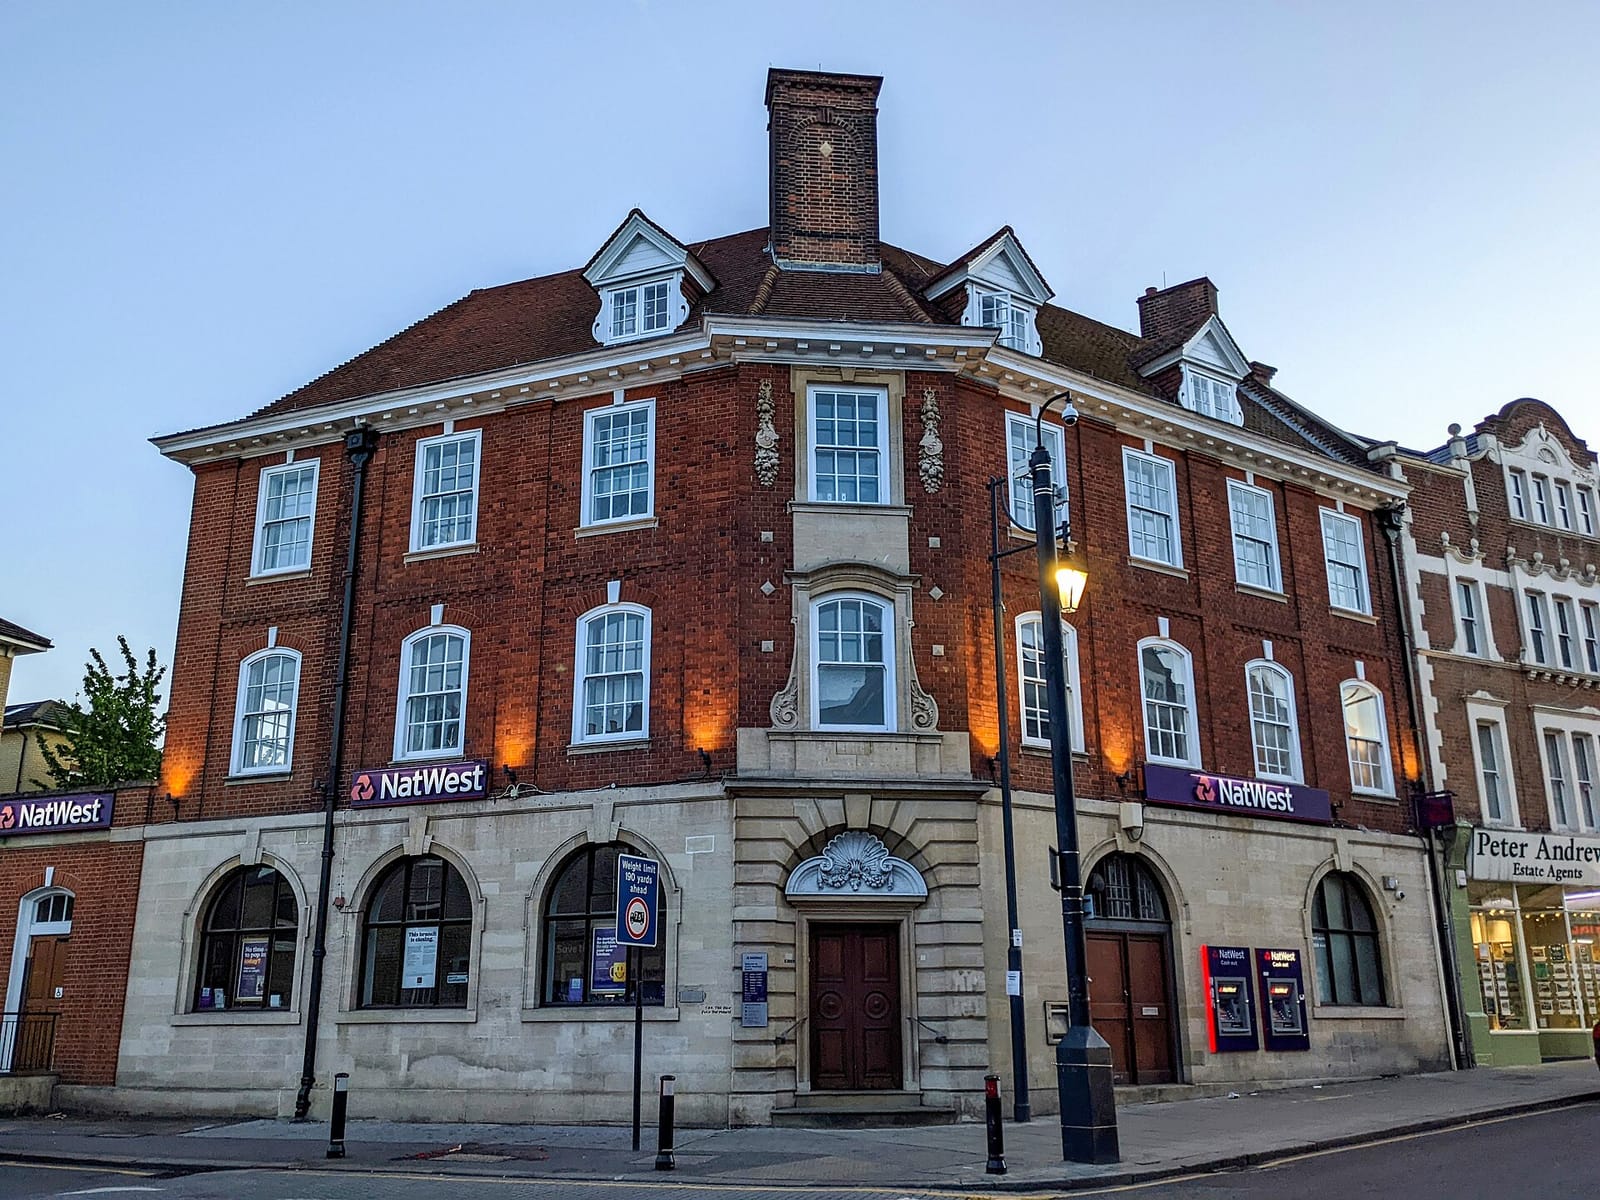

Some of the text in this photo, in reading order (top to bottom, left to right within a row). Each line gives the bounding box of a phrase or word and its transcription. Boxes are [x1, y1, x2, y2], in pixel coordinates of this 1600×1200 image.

[380, 765, 483, 799] NatWest
[1218, 779, 1294, 812] NatWest
[19, 799, 101, 827] NatWest
[1476, 832, 1528, 858] Peter
[622, 860, 641, 872] Weight
[1513, 862, 1583, 881] Estate Agents
[625, 871, 653, 885] 190 yards
[630, 884, 648, 894] ahead
[1219, 949, 1245, 959] NatWest
[1271, 951, 1296, 961] NatWest
